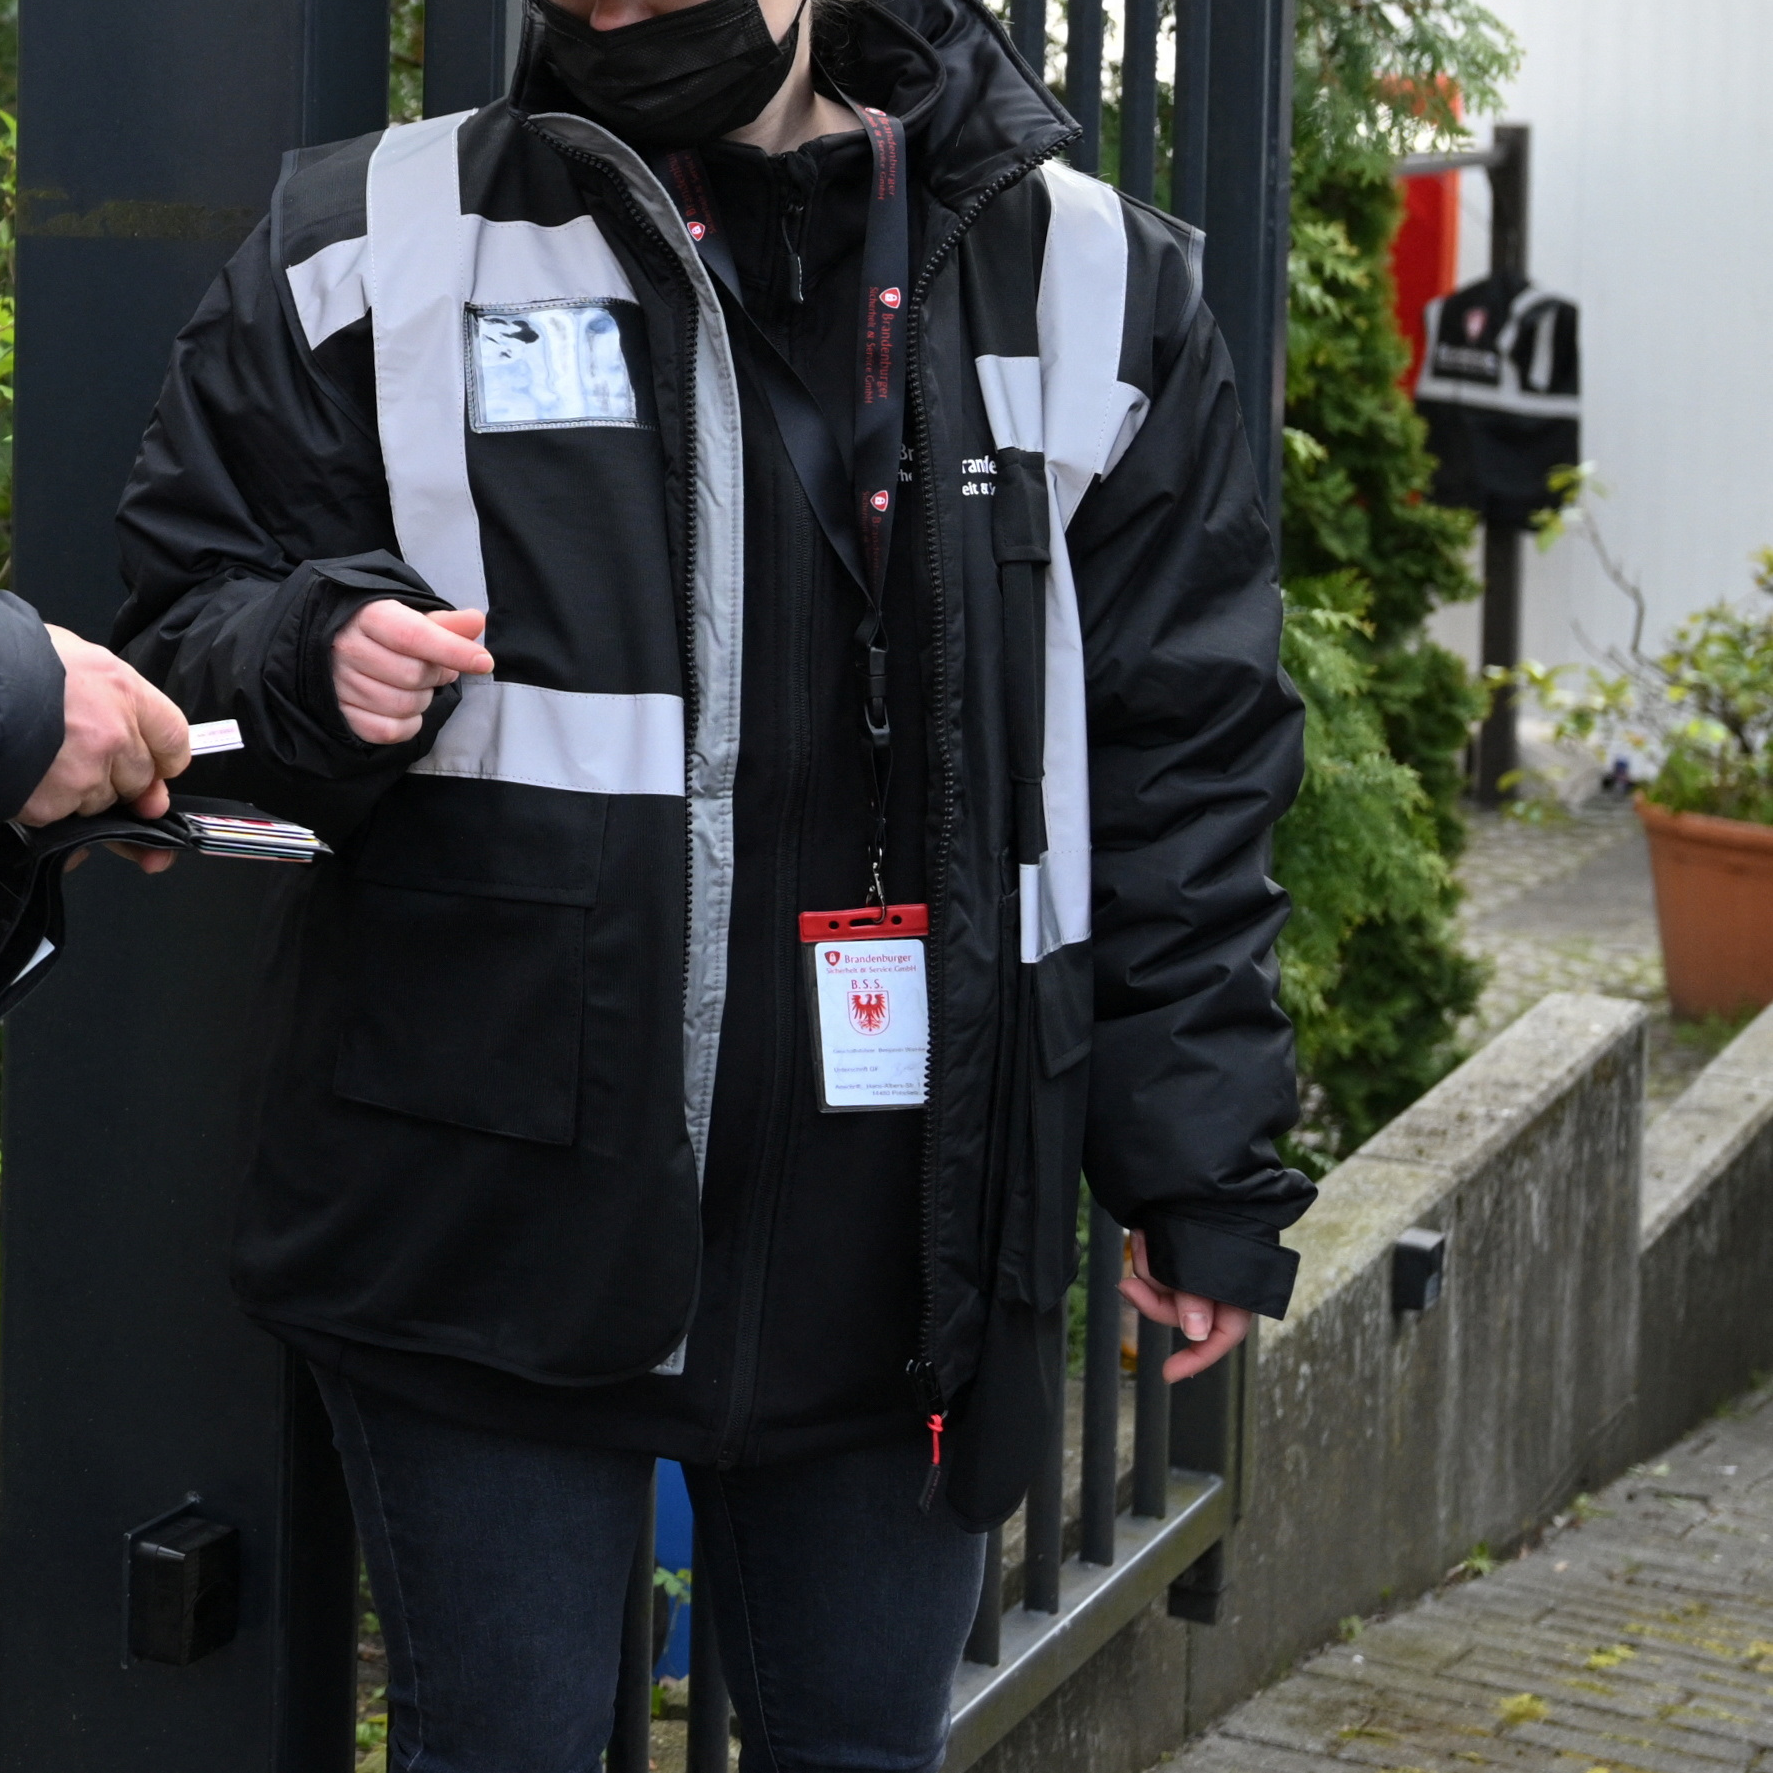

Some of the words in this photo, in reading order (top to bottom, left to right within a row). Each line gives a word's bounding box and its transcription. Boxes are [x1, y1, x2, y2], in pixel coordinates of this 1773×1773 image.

[867, 287, 879, 328] Sicherheit
[865, 343, 875, 373] Service
[877, 313, 895, 399] Brandenburger
[864, 375, 874, 404] GmbH
[844, 954, 912, 964] Brandenburger
